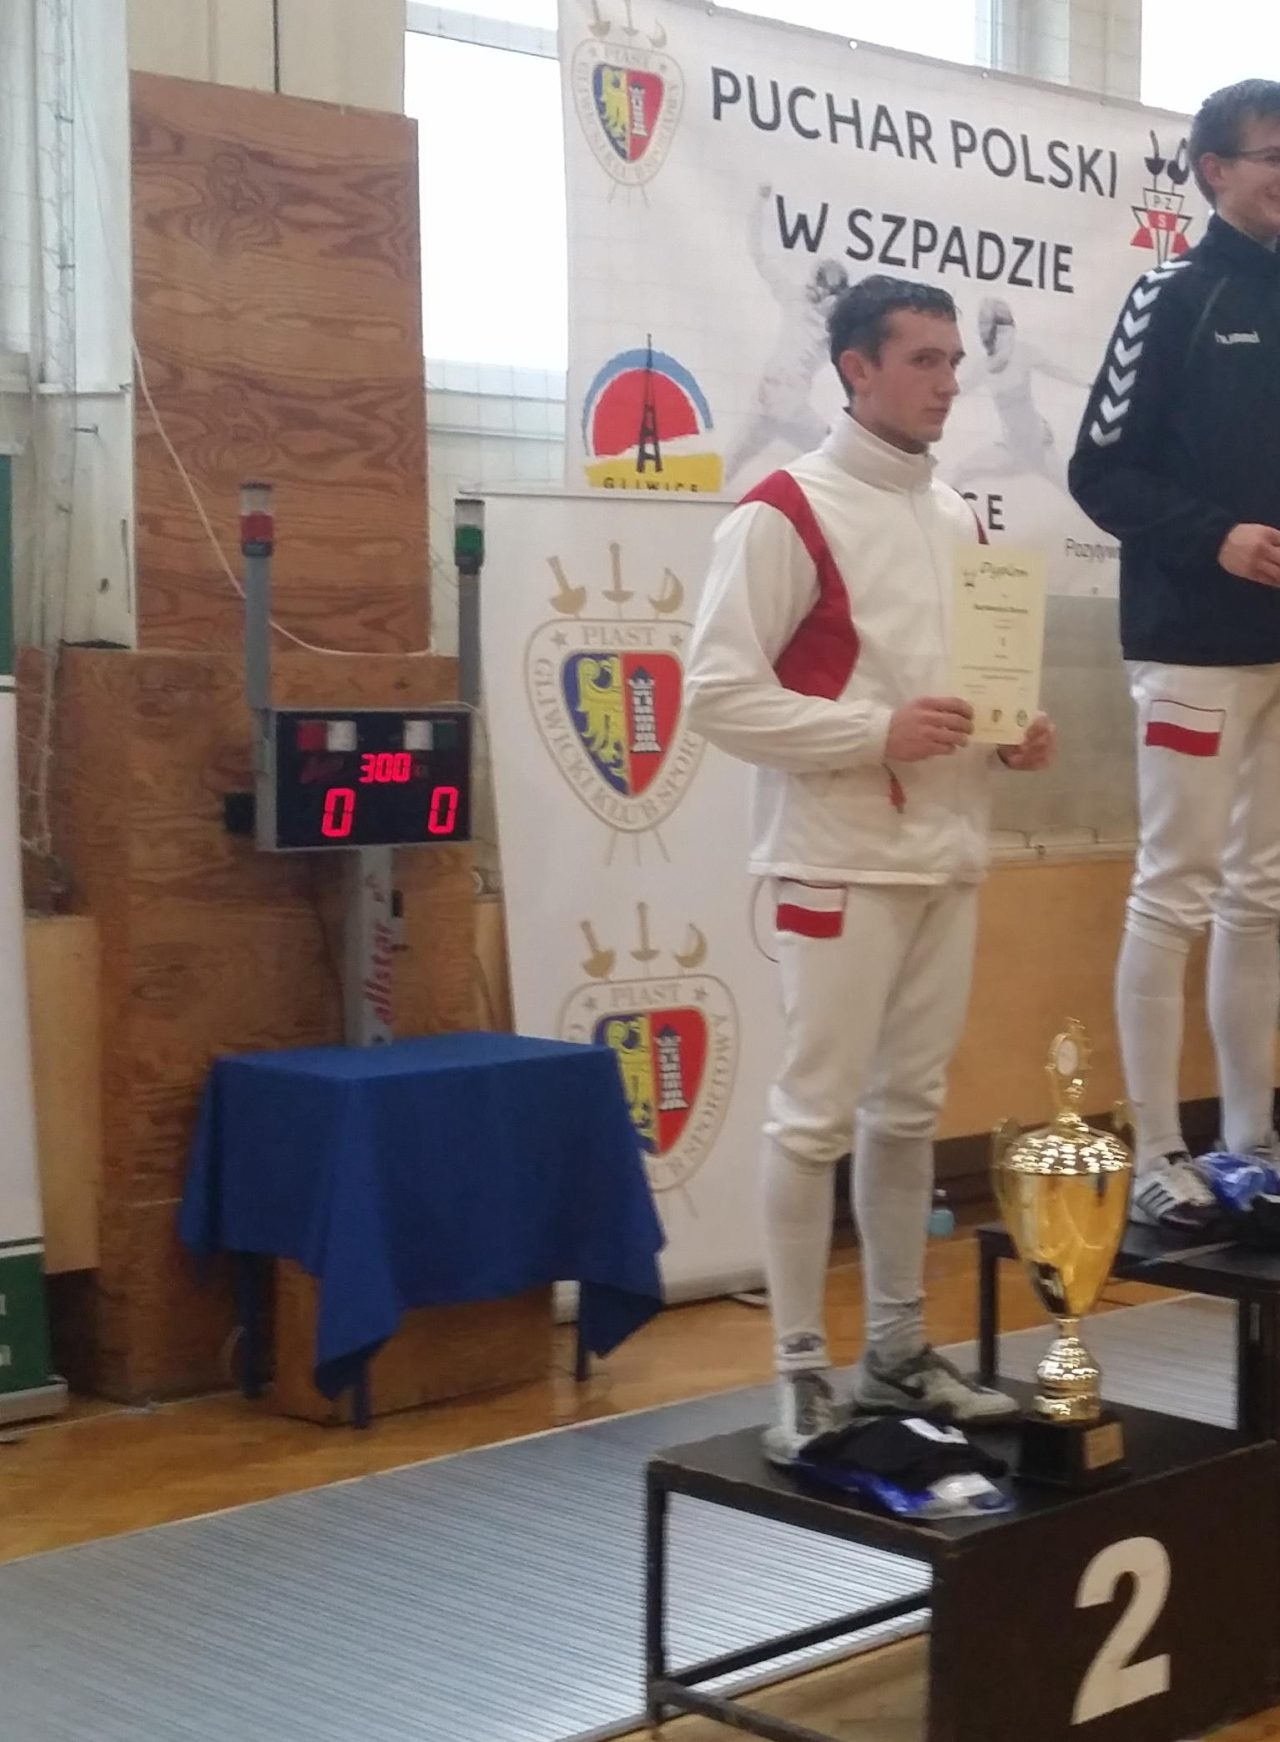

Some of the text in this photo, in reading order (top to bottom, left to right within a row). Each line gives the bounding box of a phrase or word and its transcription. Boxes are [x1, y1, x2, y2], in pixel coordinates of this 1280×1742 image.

[711, 66, 937, 164] PUCHAR
[950, 119, 1118, 199] POLSKI
[775, 194, 1074, 293] W SZPADZIE
[581, 626, 655, 647] PIAST
[321, 786, 459, 838] 0 0
[362, 921, 394, 1026] allstar
[610, 982, 682, 1005] PIAST
[1071, 1536, 1172, 1726] 2
